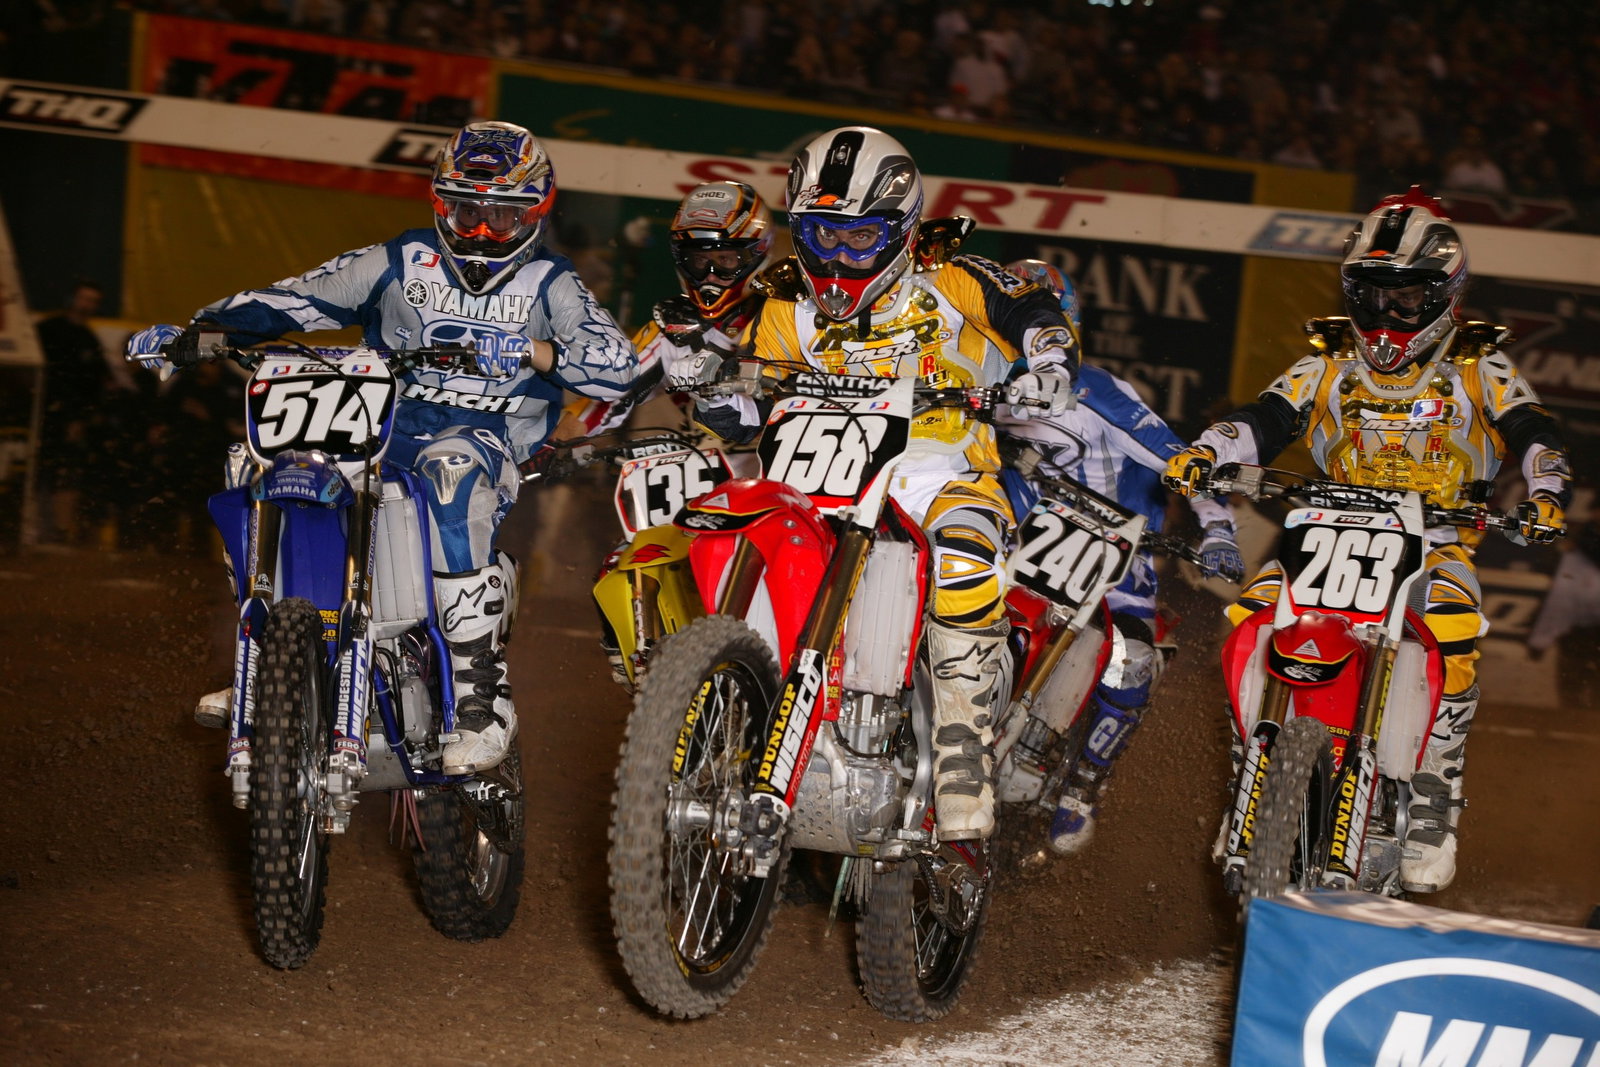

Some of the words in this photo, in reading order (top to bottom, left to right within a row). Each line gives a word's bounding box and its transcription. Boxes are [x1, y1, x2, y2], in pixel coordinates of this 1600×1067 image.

[6, 90, 133, 130] THQ
[696, 191, 726, 199] SHOEI
[432, 281, 533, 324] YAMAHA
[846, 342, 917, 365] MSR
[401, 383, 527, 414] MACH1
[796, 373, 892, 390] RENTHA
[257, 380, 391, 449] 514
[1359, 418, 1430, 431] MSR
[660, 455, 688, 464] THQ
[766, 414, 889, 498] 158
[268, 485, 317, 499] YAMAHA
[1071, 514, 1097, 530] THQ
[1339, 516, 1368, 525] THQ
[1015, 511, 1122, 604] 240
[1291, 527, 1405, 613] 263
[334, 648, 353, 737] BRIDGESTONE
[758, 684, 796, 780] DUNLOP
[770, 671, 823, 796] WISECO
[1228, 734, 1262, 854] WISECO
[1331, 766, 1358, 859] DUNLOP
[1342, 749, 1376, 871] WISECO
